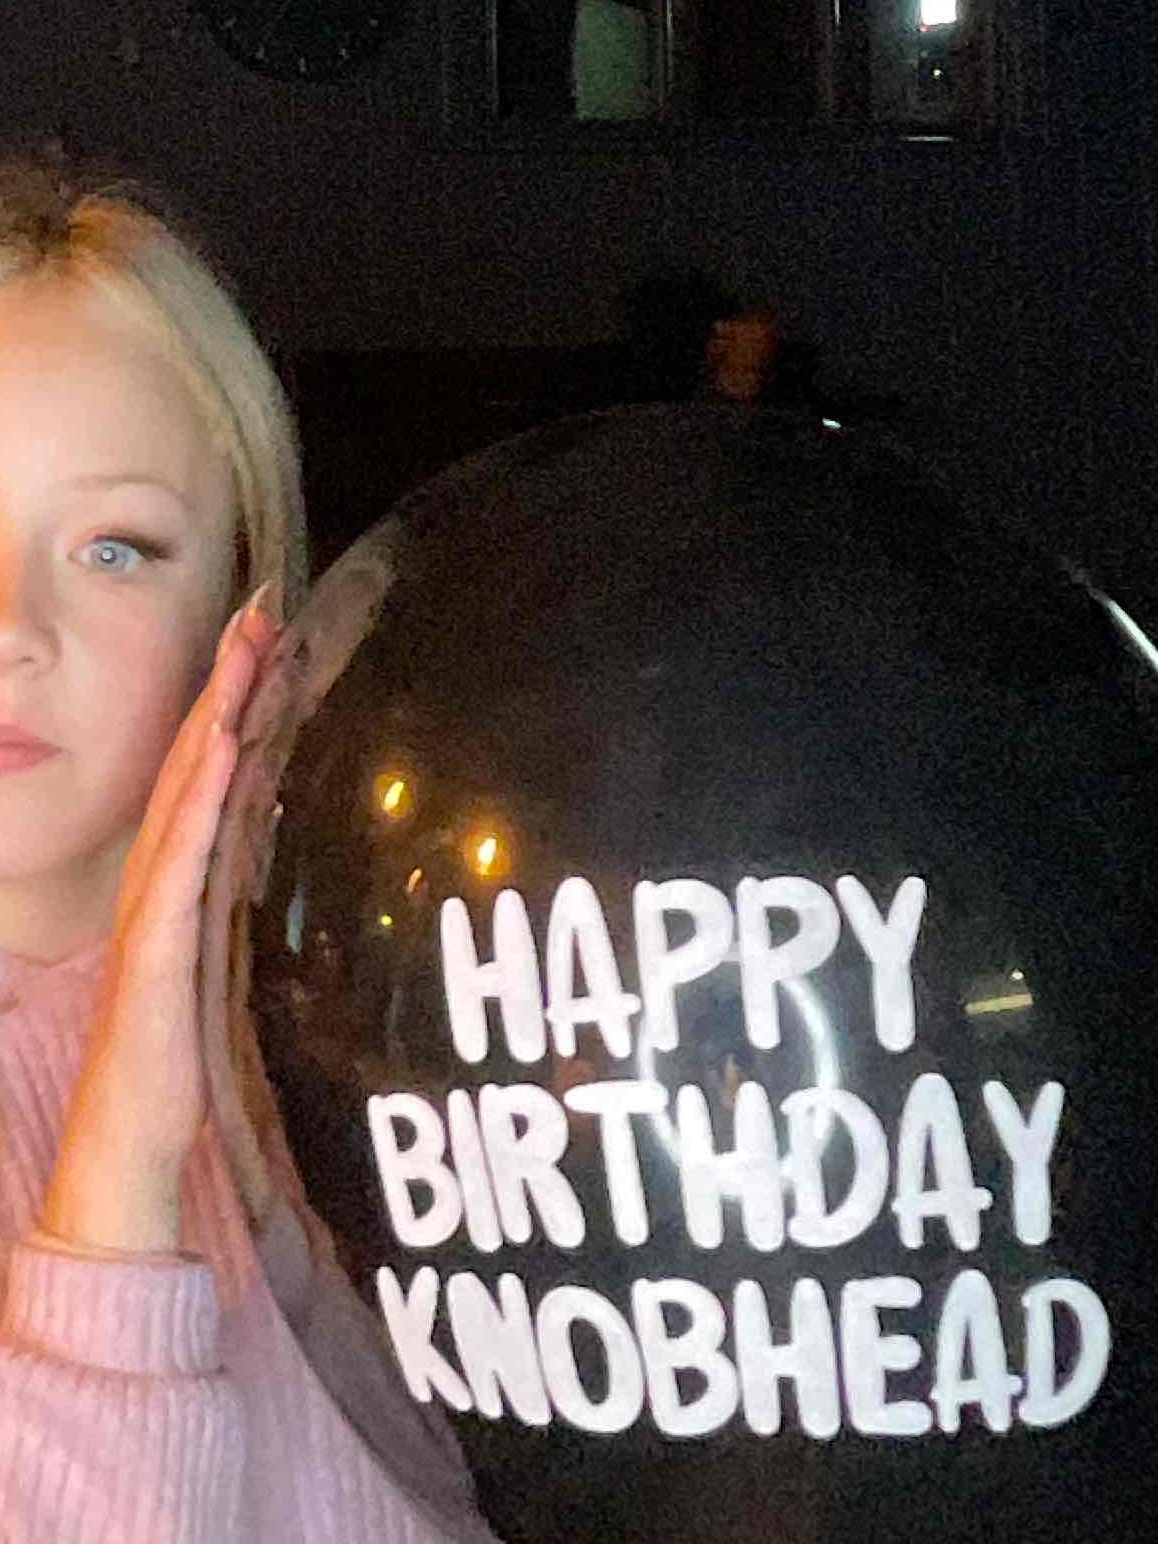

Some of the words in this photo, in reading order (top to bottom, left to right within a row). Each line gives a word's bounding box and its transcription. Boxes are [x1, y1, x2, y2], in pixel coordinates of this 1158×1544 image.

[441, 875, 927, 1063] HAPPY
[367, 1072, 1065, 1252] BIRTHDAY
[375, 1266, 1111, 1439] KNOBHEAD
